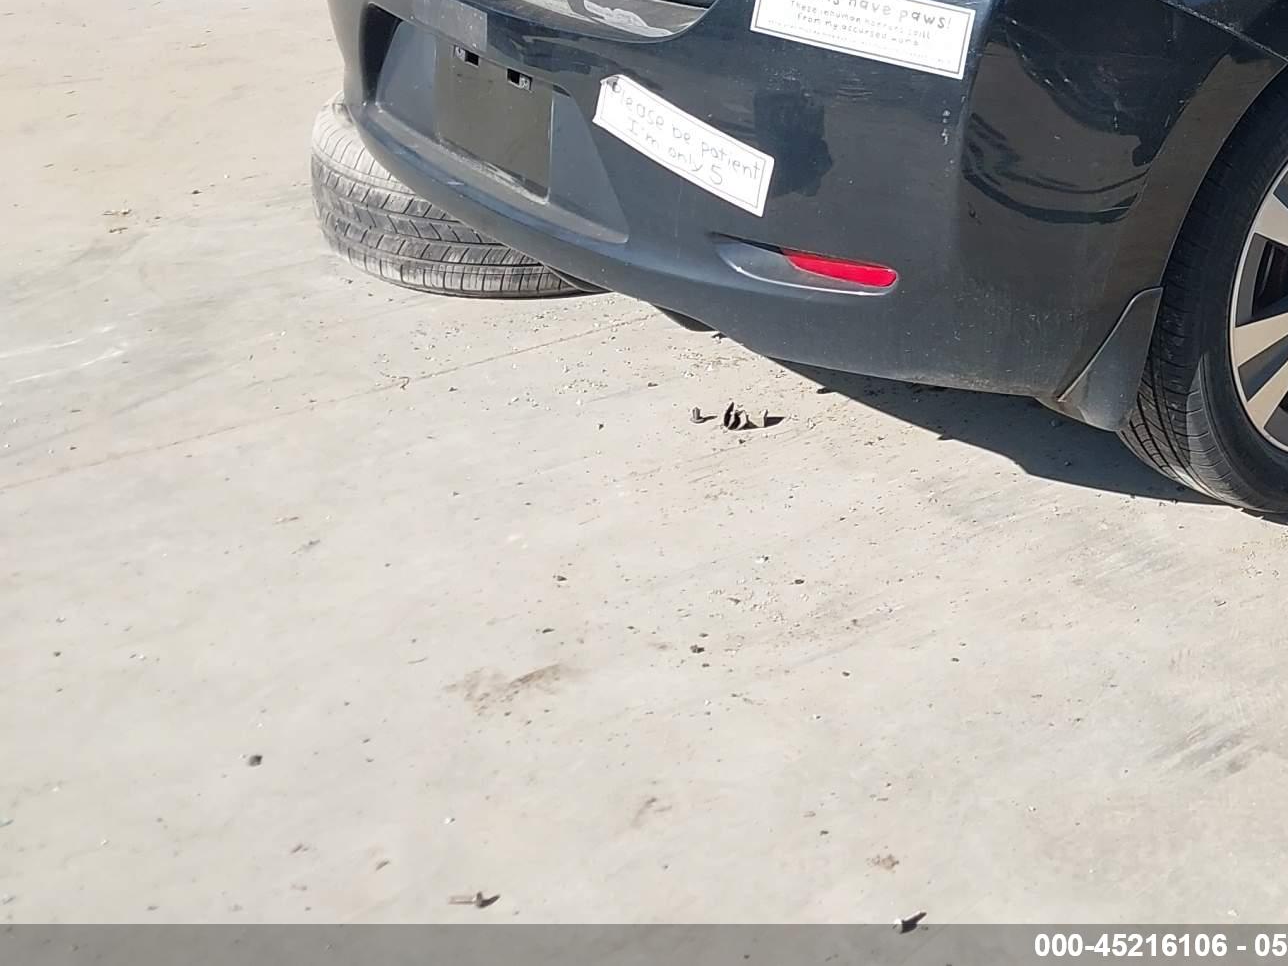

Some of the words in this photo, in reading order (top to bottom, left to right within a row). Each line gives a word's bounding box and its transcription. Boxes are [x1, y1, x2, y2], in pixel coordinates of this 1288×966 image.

[790, 0, 817, 15] These
[898, 6, 953, 30] paws!
[824, 19, 839, 31] my
[628, 119, 661, 149] I'm
[667, 146, 704, 173] only
[709, 164, 724, 186] 5
[671, 122, 692, 144] be
[700, 140, 761, 181] patient
